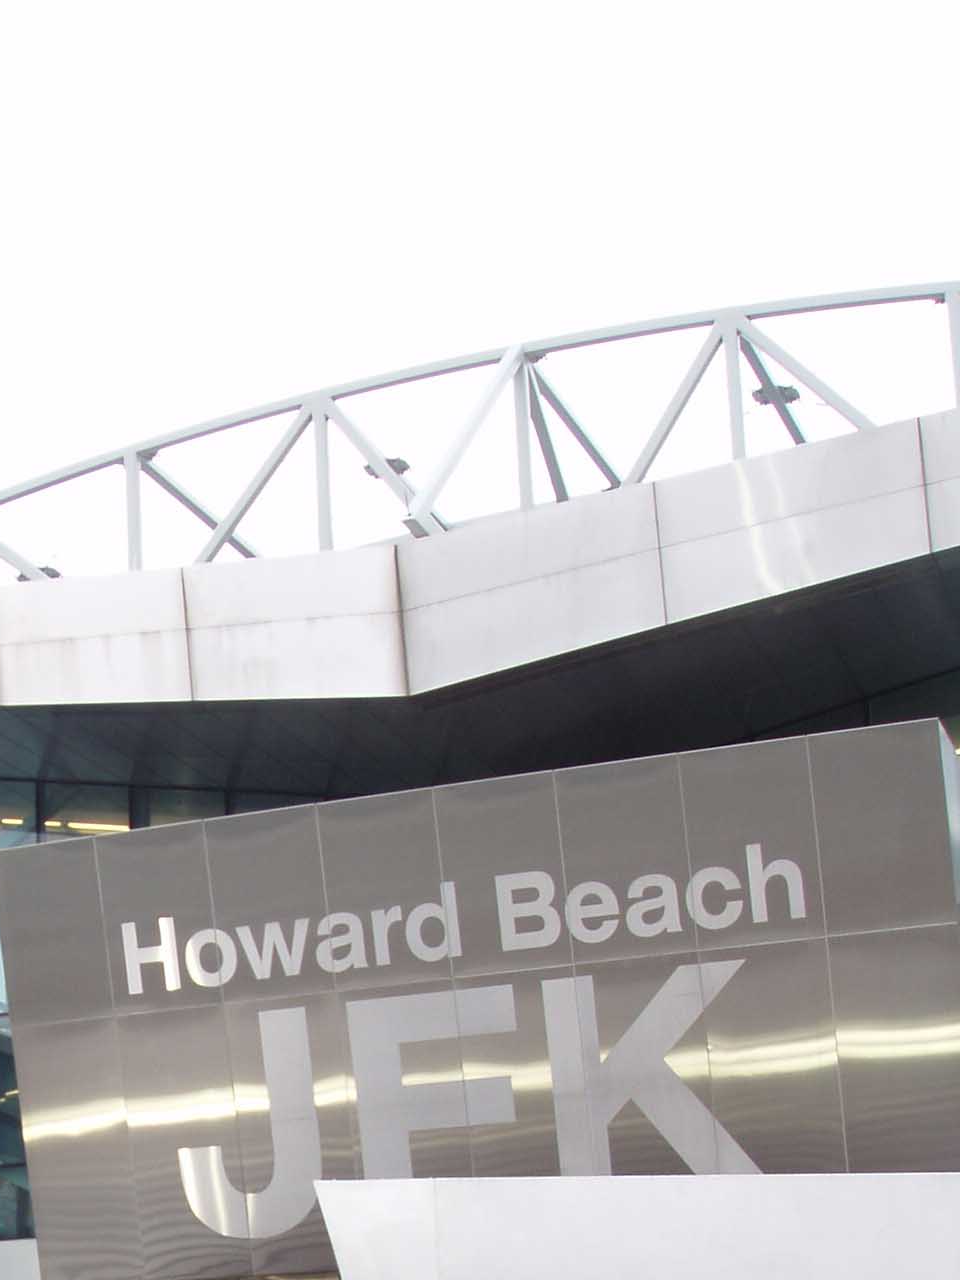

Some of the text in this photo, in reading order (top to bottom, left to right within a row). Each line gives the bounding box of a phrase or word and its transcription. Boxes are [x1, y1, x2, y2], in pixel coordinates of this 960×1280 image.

[121, 843, 807, 995] Howard Beach
[177, 959, 765, 1239] JFK
